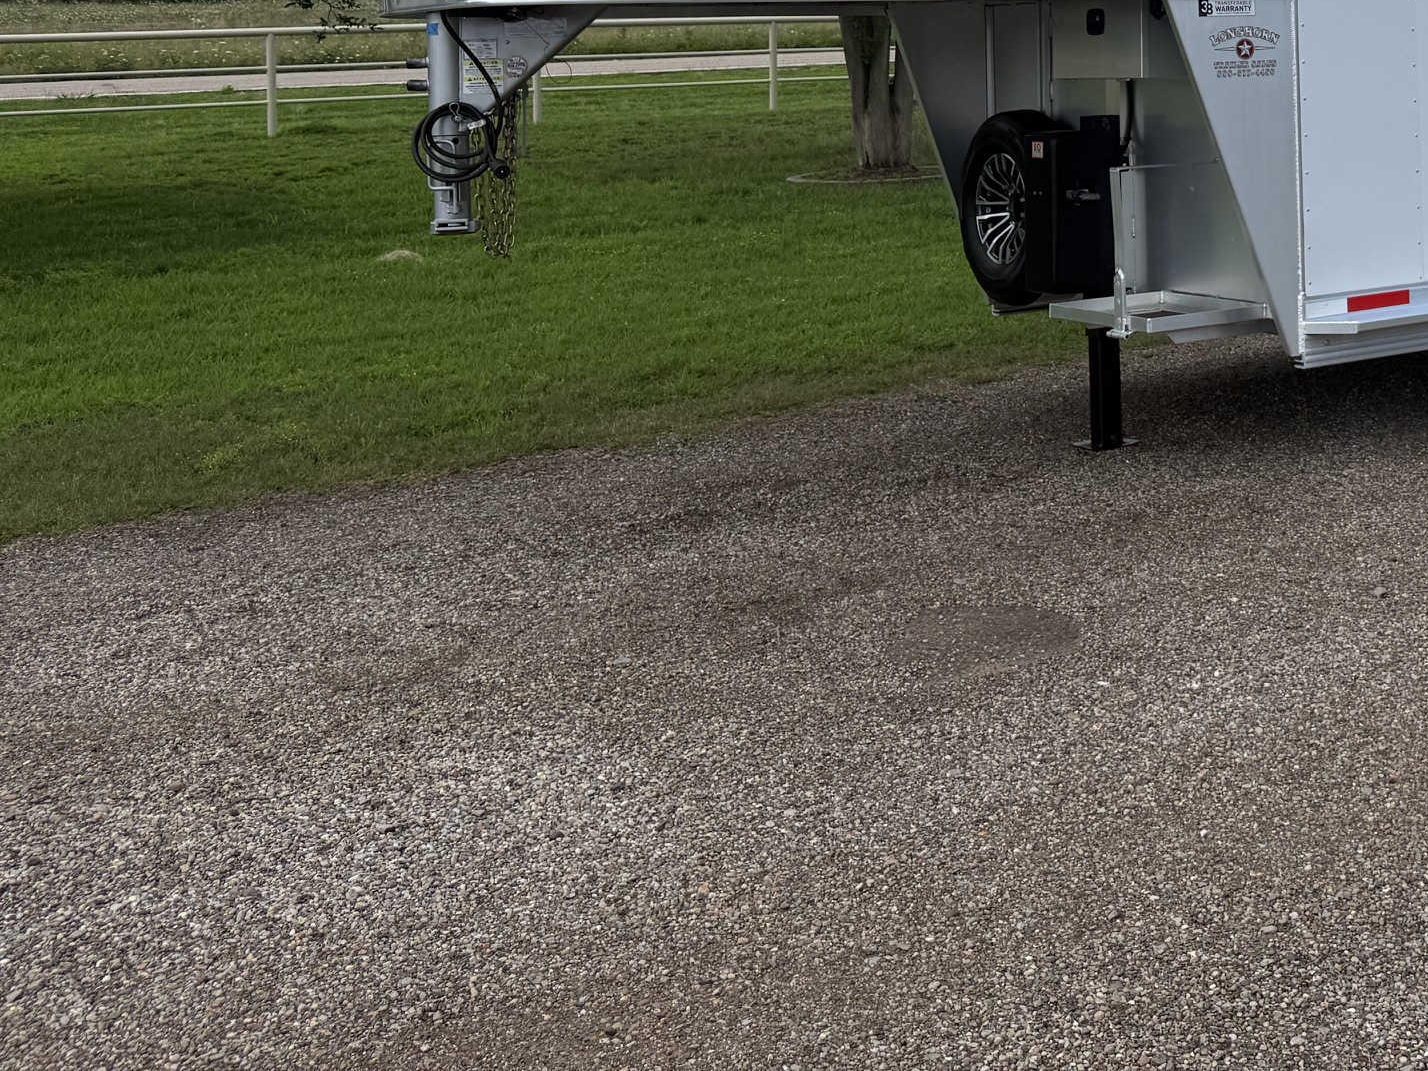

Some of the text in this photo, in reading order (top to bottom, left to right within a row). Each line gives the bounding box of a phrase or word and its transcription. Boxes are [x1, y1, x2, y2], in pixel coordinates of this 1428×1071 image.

[1209, 26, 1280, 47] LONGHORN
[1213, 60, 1277, 69] TRAILER SALES
